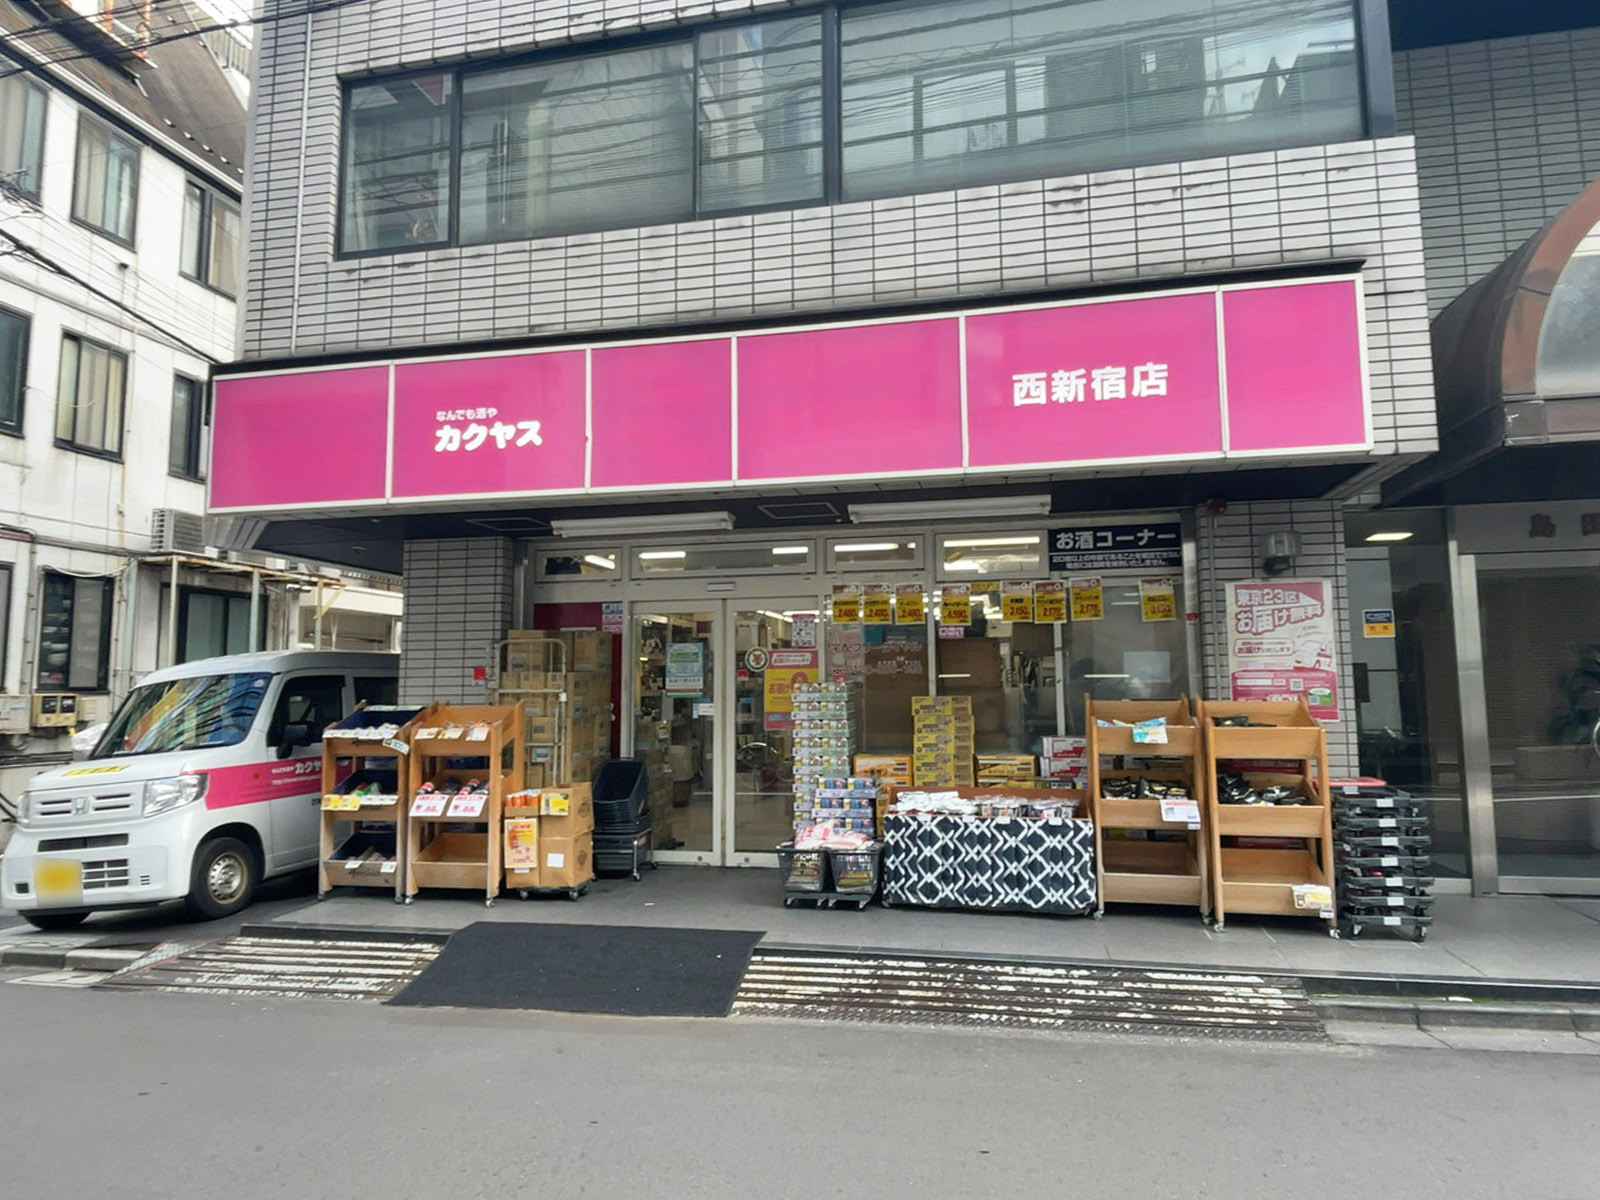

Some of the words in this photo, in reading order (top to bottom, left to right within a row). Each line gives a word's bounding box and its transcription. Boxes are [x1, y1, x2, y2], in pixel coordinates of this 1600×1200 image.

[1012, 362, 1169, 406] 西新宿店
[436, 407, 498, 422] なんでも酒や
[434, 420, 543, 453] カクヤス
[1056, 529, 1177, 549] お酒コーナー
[1236, 588, 1298, 606] 東京23区
[1236, 606, 1323, 634] お届け無料
[295, 759, 322, 775] カクヤ
